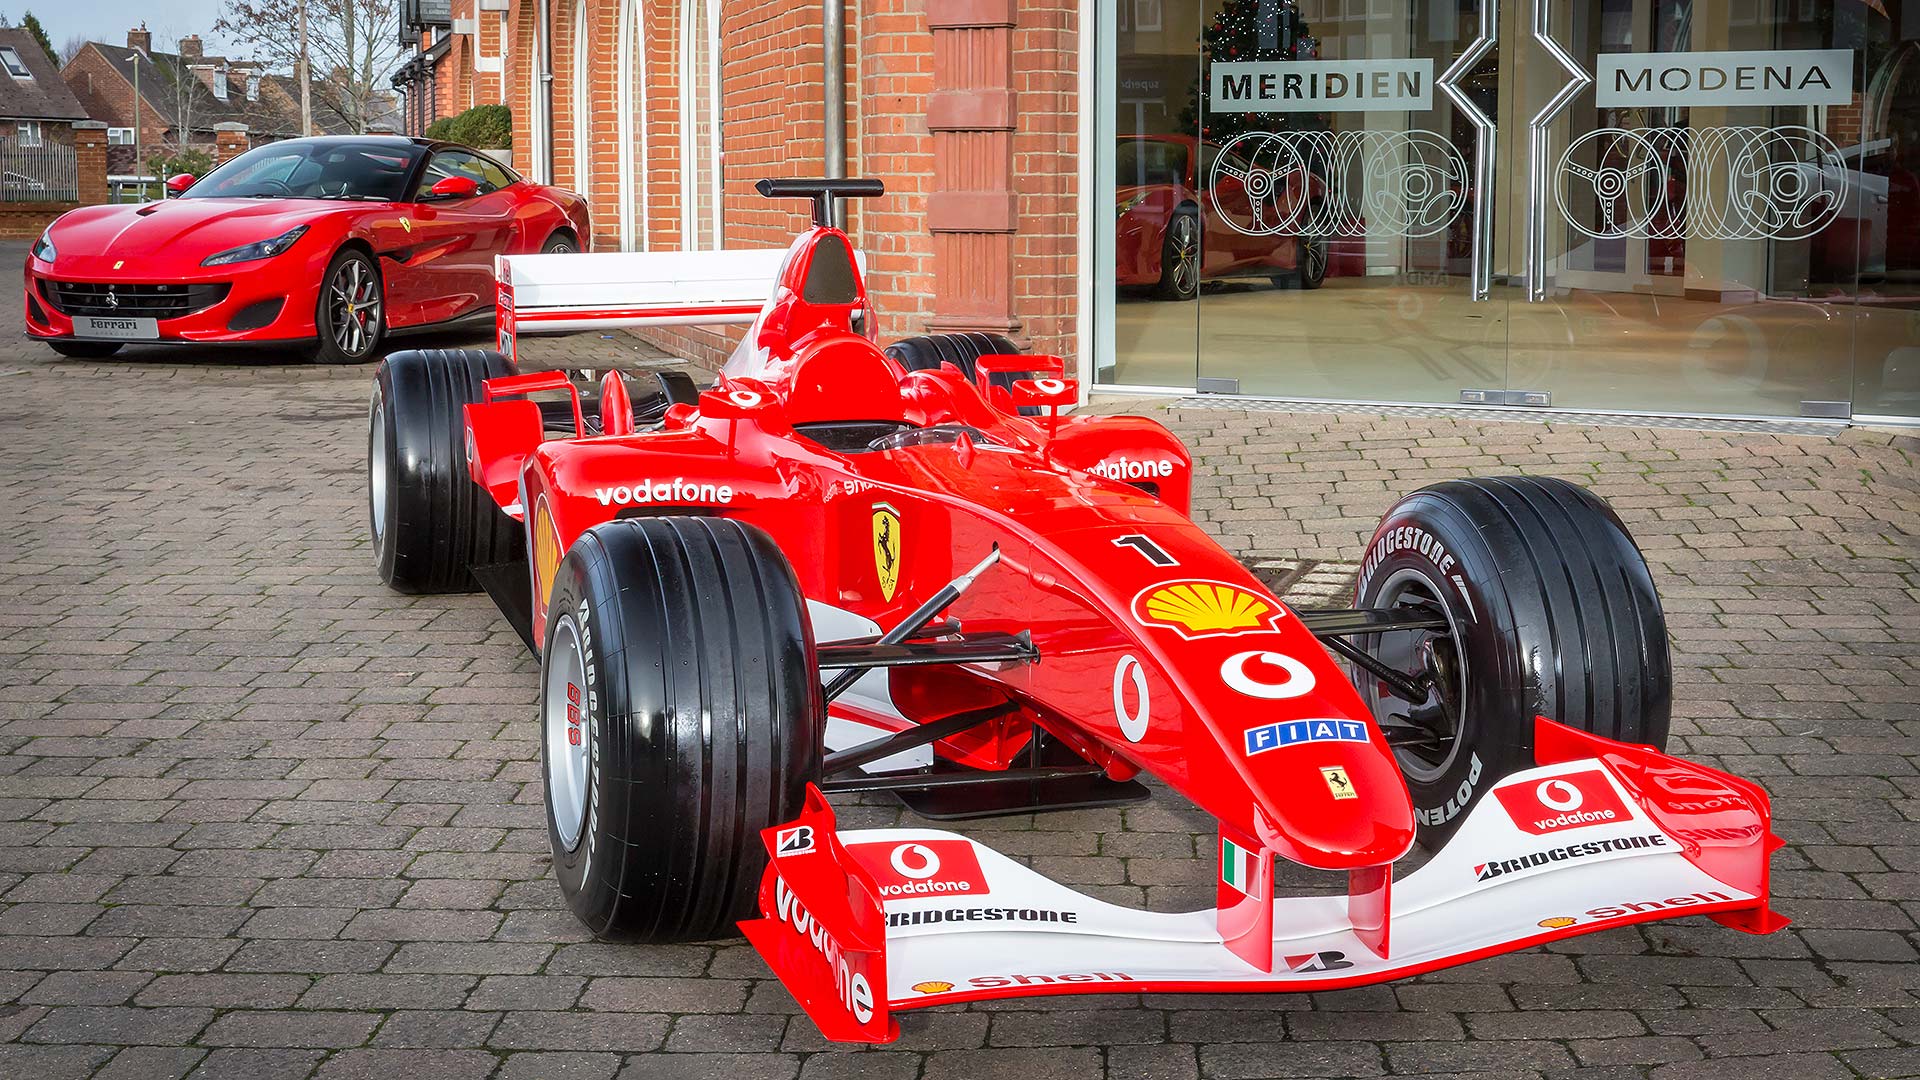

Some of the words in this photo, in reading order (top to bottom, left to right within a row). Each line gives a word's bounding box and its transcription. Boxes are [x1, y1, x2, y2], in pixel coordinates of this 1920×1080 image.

[1222, 71, 1421, 100] MERIDIEN
[1615, 65, 1831, 92] MODENA
[89, 318, 138, 330] Ferrari
[595, 477, 733, 506] vodafone
[1111, 533, 1181, 568] 1
[567, 681, 581, 747] BBS
[1254, 722, 1360, 748] FIAT
[1533, 808, 1616, 830] vodafone
[1473, 834, 1667, 882] BRIDGESTONE
[1585, 890, 1734, 920] Shell
[968, 972, 1135, 988] Shell
